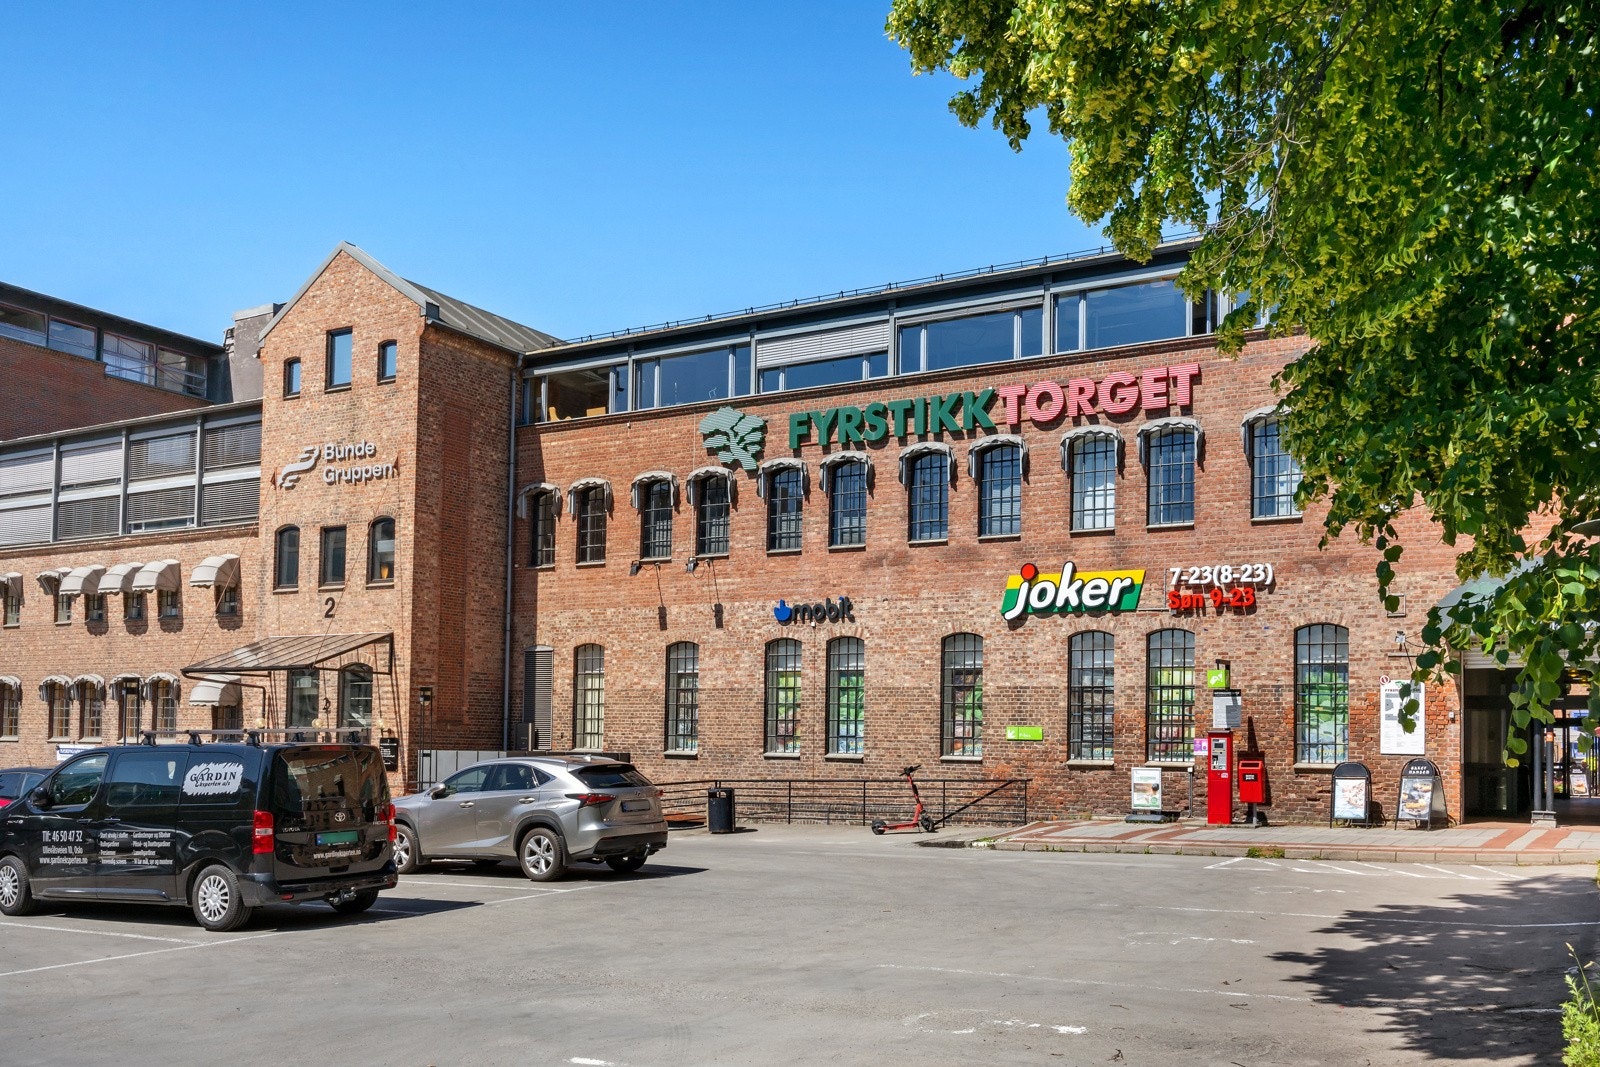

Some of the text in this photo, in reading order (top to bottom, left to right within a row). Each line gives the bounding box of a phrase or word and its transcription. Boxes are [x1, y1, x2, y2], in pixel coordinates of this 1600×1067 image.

[324, 439, 375, 459] Bunde
[323, 463, 393, 483] Gruppen
[1004, 561, 1133, 620] joker
[1168, 587, 1255, 608] Søn 9-23
[324, 596, 336, 618] 2
[190, 771, 237, 781] GARDIN
[52, 830, 60, 842] 46
[60, 830, 68, 842] 50
[68, 830, 75, 842] 47
[75, 830, 83, 842] 32
